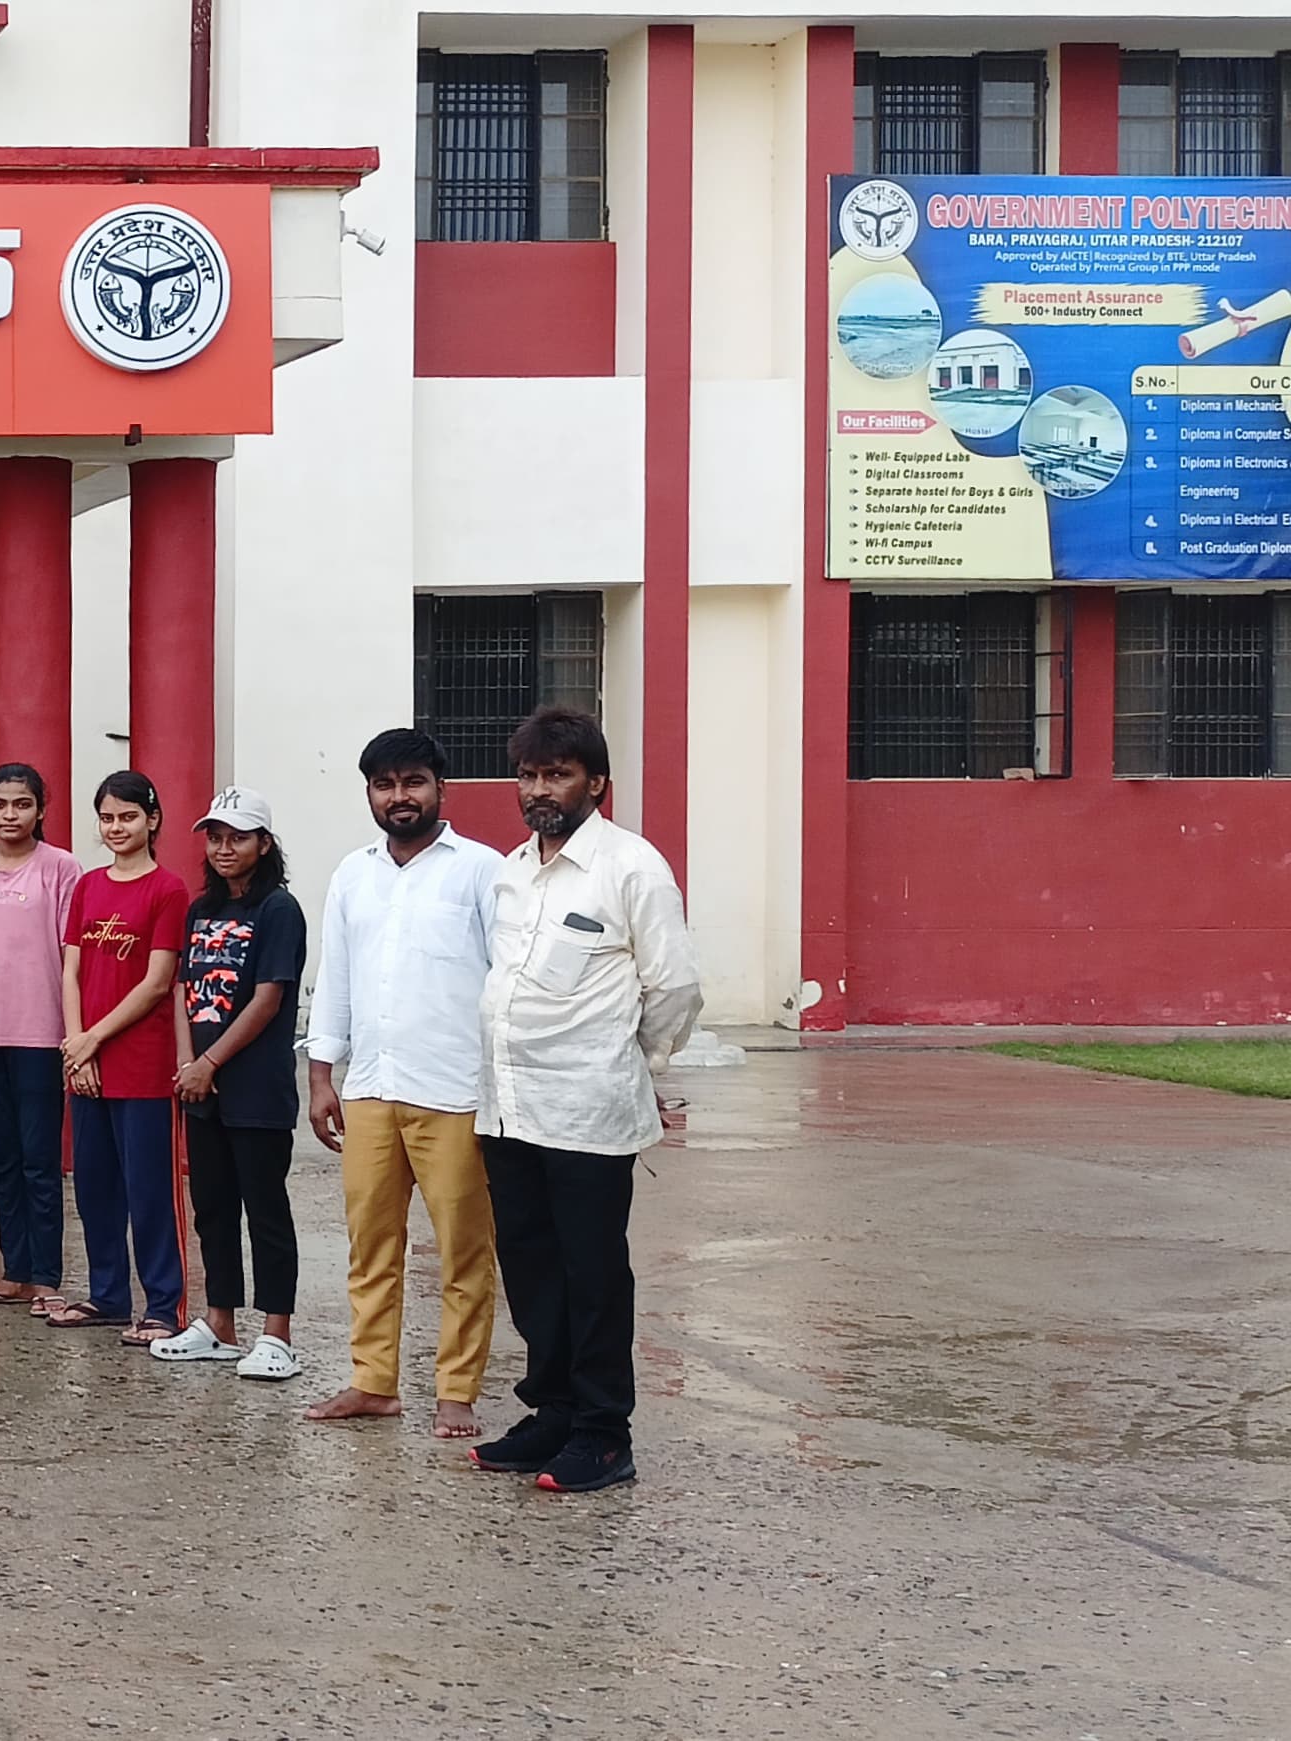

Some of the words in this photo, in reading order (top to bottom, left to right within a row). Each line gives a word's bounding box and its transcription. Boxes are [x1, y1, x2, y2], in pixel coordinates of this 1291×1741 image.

[927, 194, 1126, 229] GOVERNMENT
[969, 233, 1007, 248] BARA,
[1011, 233, 1087, 248] PRAYAGRAJ,
[1090, 234, 1128, 247] UTTAR
[1197, 234, 1243, 247] 212107
[107, 218, 166, 241] प्रदेश
[171, 225, 215, 284] सरकार
[1003, 289, 1083, 304] Placement
[1087, 290, 1163, 304] Assurance
[1024, 306, 1050, 317] 500+
[1053, 306, 1096, 318] Industry
[1099, 306, 1143, 317] Connect
[1250, 376, 1276, 388] Our
[843, 416, 866, 428] Our
[869, 416, 926, 428] Facilities
[1145, 429, 1158, 440] 2.
[1180, 429, 1221, 442] Diploma
[1223, 429, 1233, 440] in
[1234, 428, 1281, 442] Computer
[894, 452, 943, 464] Equipped
[946, 452, 970, 462] Labs
[1180, 456, 1221, 470] Diploma
[1223, 456, 1233, 468] in
[1235, 456, 1288, 469] Electronics
[865, 469, 900, 480] Digital
[903, 469, 964, 479] Classrooms
[865, 487, 913, 498] Separate
[915, 487, 949, 497] hostel
[951, 487, 966, 497] for
[969, 487, 994, 498] Boys
[998, 487, 1005, 497] &
[1009, 487, 1034, 497] Girls
[1180, 485, 1239, 500] Engineering
[865, 504, 927, 515] Scholarship
[930, 504, 944, 514] for
[947, 504, 1007, 514] Candidates
[865, 521, 911, 532] Hygienic
[914, 521, 963, 531] Cafeteria
[865, 538, 888, 548] Wi-fi
[891, 538, 933, 549] Campus
[865, 555, 895, 565] CCTV
[898, 555, 963, 565] Surveillance
